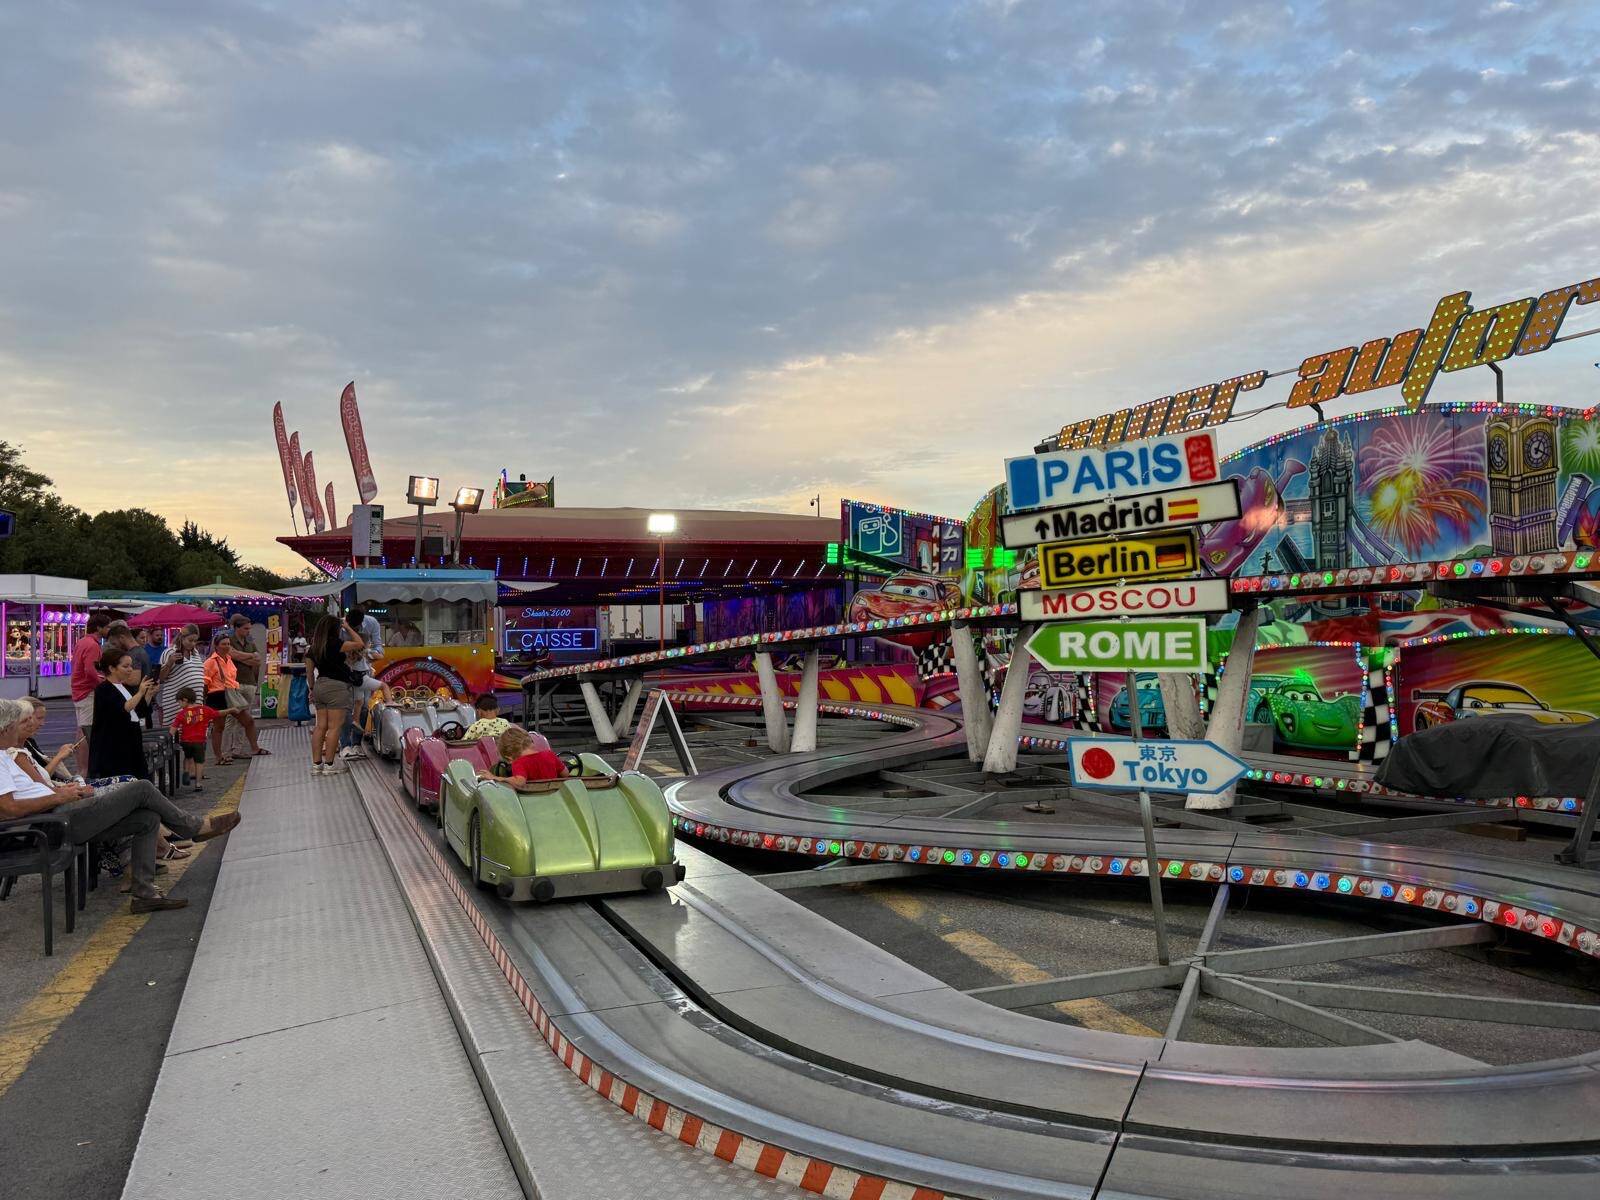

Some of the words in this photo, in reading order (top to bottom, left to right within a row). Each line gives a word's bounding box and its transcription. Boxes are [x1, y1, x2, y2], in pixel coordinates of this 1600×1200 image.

[1043, 442, 1182, 497] PARIS
[1052, 498, 1163, 538] Madrid
[1053, 546, 1150, 578] Berlin
[1042, 586, 1196, 615] MOSCOU
[267, 614, 280, 689] BOXER
[521, 632, 582, 648] CAISSE
[1058, 631, 1194, 661] ROME
[1138, 744, 1178, 762] 東京
[1122, 760, 1208, 789] Tokyo
